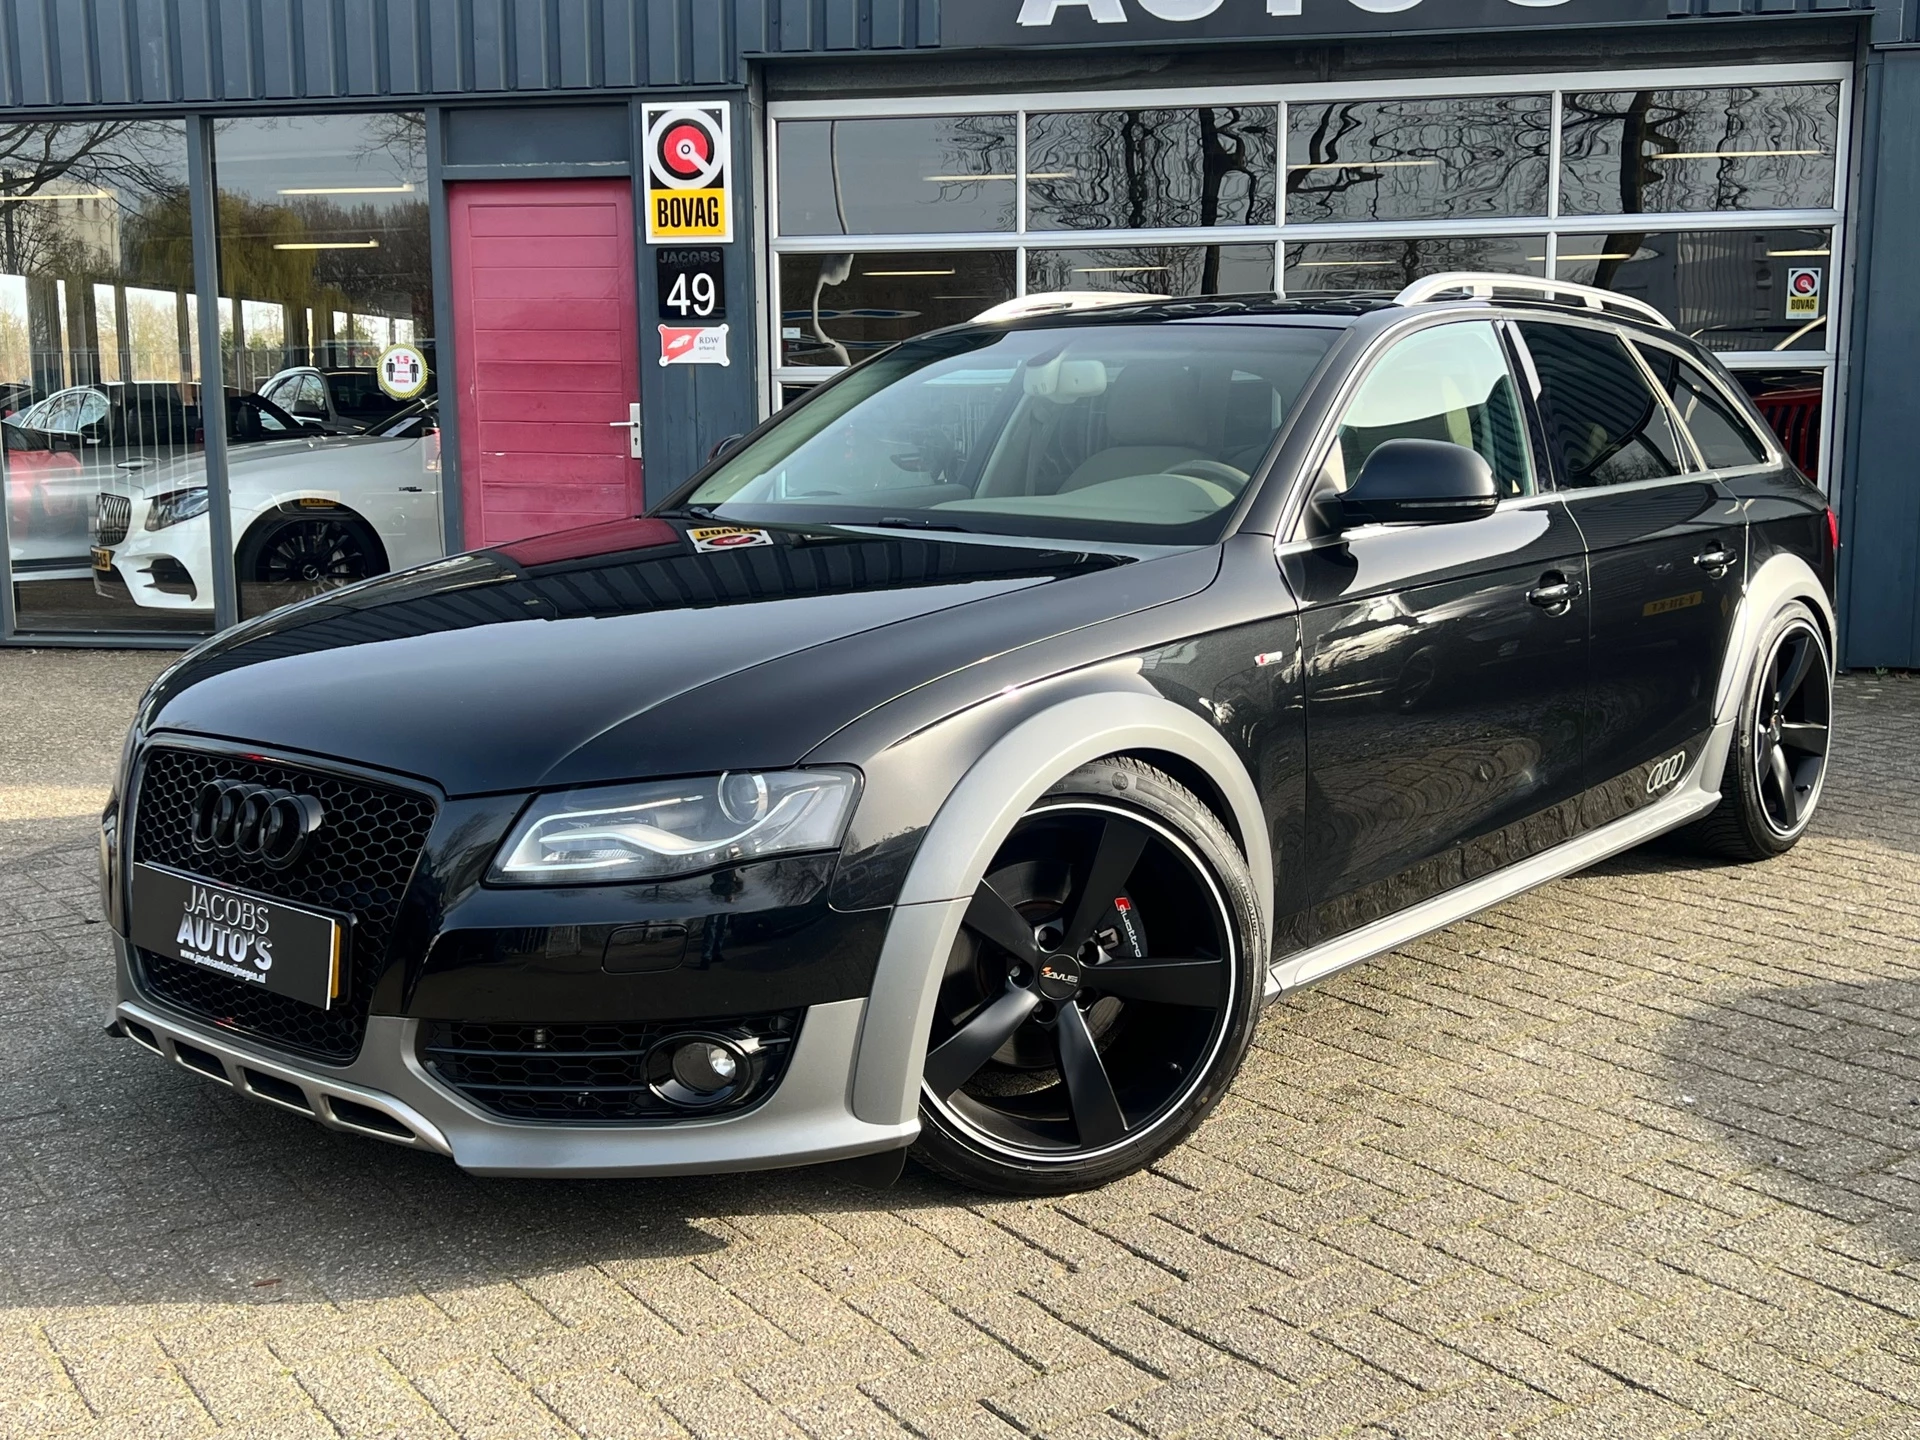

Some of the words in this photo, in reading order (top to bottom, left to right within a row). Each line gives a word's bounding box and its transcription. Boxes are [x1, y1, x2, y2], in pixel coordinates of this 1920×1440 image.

[657, 196, 719, 228] BOVAG
[660, 251, 720, 263] JACOBS
[667, 273, 716, 316] 49
[1791, 299, 1814, 310] BOVAG
[699, 336, 720, 344] RDW
[396, 355, 409, 364] 1.5
[184, 885, 269, 934] JACOBS
[176, 912, 273, 971] AUTO'S
[1119, 904, 1142, 958] quattro
